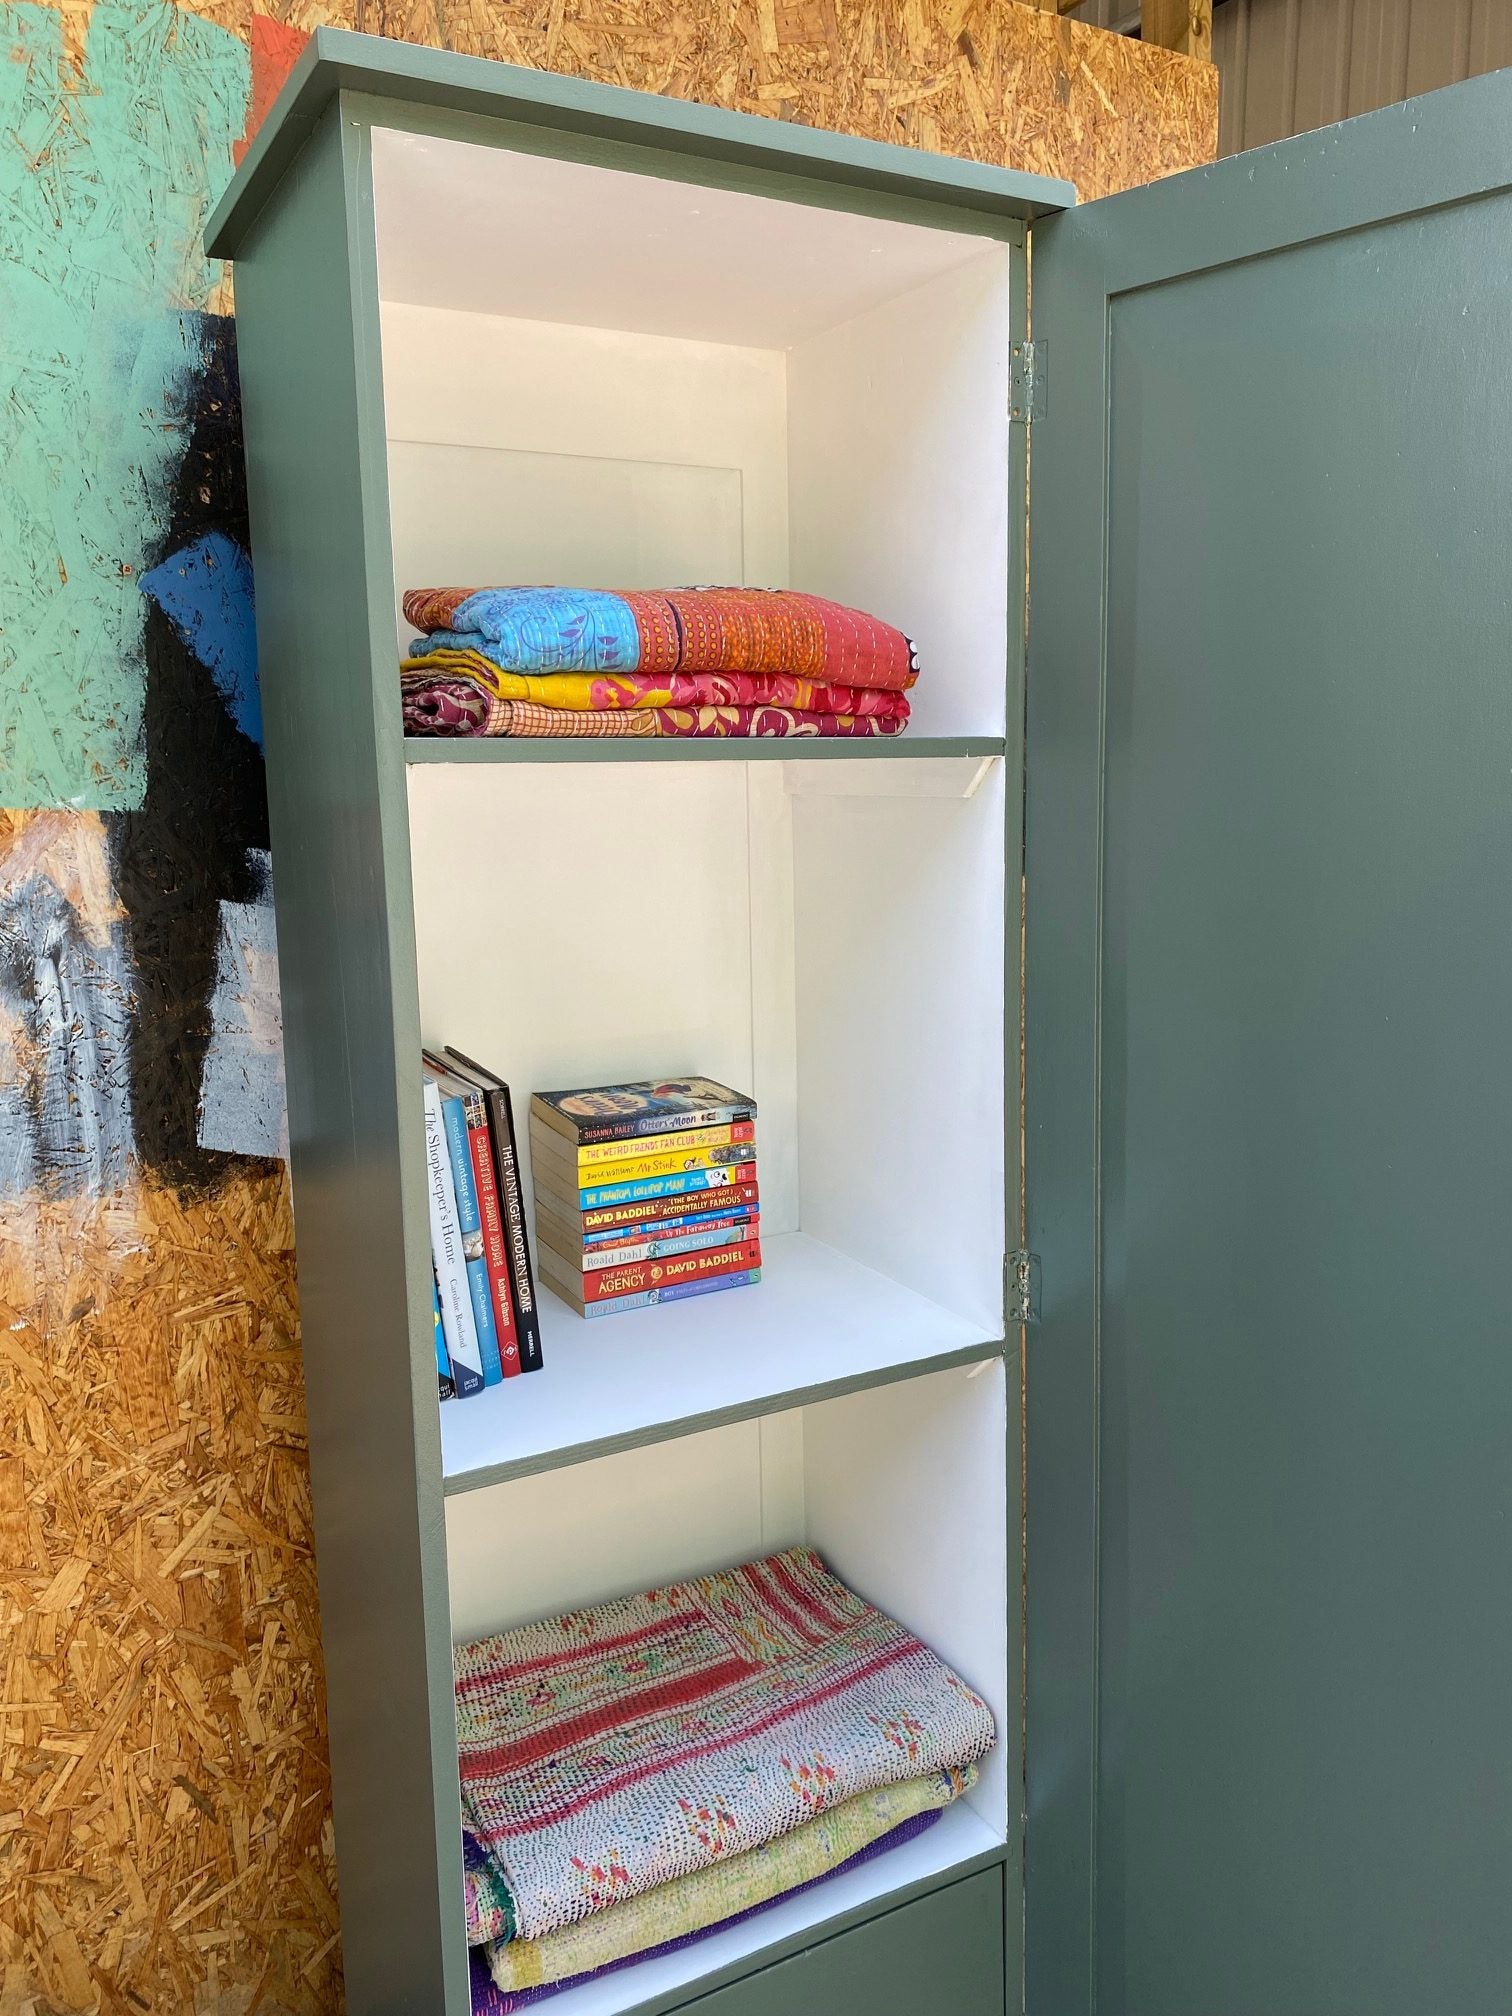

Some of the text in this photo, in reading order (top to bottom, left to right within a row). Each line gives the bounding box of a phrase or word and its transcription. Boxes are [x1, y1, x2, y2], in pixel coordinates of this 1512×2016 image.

[584, 1124, 634, 1139] SUSANNA BAILEY
[670, 1116, 696, 1128] Moon
[586, 1150, 600, 1160] THE
[603, 1144, 628, 1156] WEIRD
[630, 1140, 658, 1153] FRIENDS
[660, 1137, 675, 1148] FAN
[676, 1135, 695, 1146] CLUB
[451, 1116, 476, 1222] modern vintage style
[637, 1158, 676, 1172] Mr Stink
[424, 1109, 456, 1264] The Shopkeeper's Home
[585, 1194, 598, 1204] THE
[600, 1188, 631, 1202] PHANTOM
[634, 1182, 664, 1196] LOLLIPOP
[700, 1192, 716, 1200] WHO
[586, 1206, 656, 1226] DAVID BADDIEL
[662, 1201, 707, 1216] ACCIDENTALLY
[710, 1196, 741, 1208] FAMOUS
[502, 1144, 532, 1314] THE VINTAGE MODERN HOME
[686, 1224, 716, 1234] Faraway
[664, 1236, 714, 1251] GOING SOLO
[588, 1250, 642, 1268] Roald Dahl
[666, 1250, 744, 1276] DAVID BADDIEL
[599, 1272, 646, 1294] AGENCY
[602, 1266, 642, 1280] THE PARENT
[476, 1273, 488, 1328] Emily Chalmers
[496, 1278, 510, 1327] Ashlyn Gibson
[591, 1296, 645, 1315] Roald Dahl
[450, 1278, 468, 1348] Caroline Rowland
[527, 1330, 536, 1358] MERRELL
